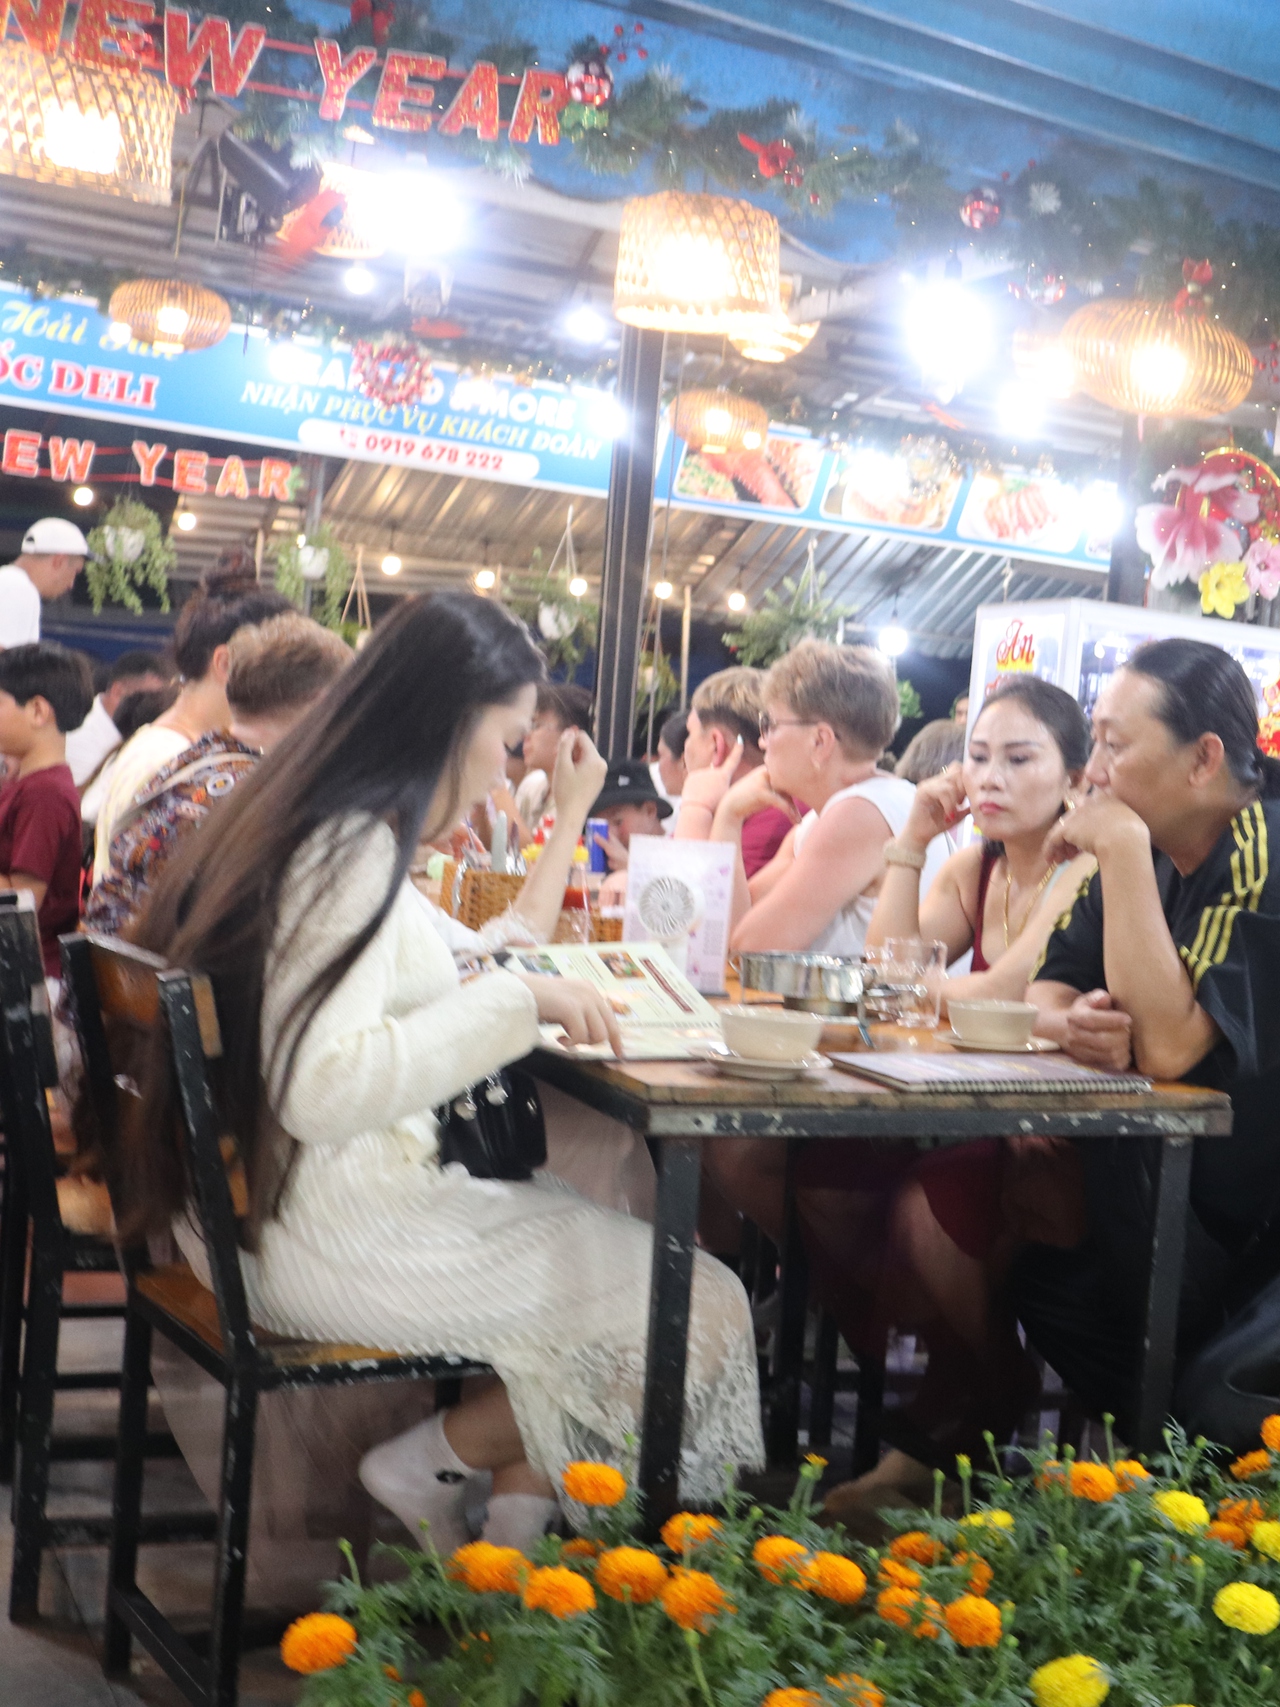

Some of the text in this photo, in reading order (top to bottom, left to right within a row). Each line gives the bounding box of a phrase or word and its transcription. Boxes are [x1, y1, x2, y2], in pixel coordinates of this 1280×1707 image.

[2, 0, 570, 146] NEW YEAR
[48, 359, 160, 411] DELI
[241, 381, 320, 415] NHẬN
[404, 408, 436, 435] VỤ
[439, 416, 528, 447] KHÁCH
[132, 440, 292, 501] YEAR
[364, 433, 505, 471] 0919 678 222
